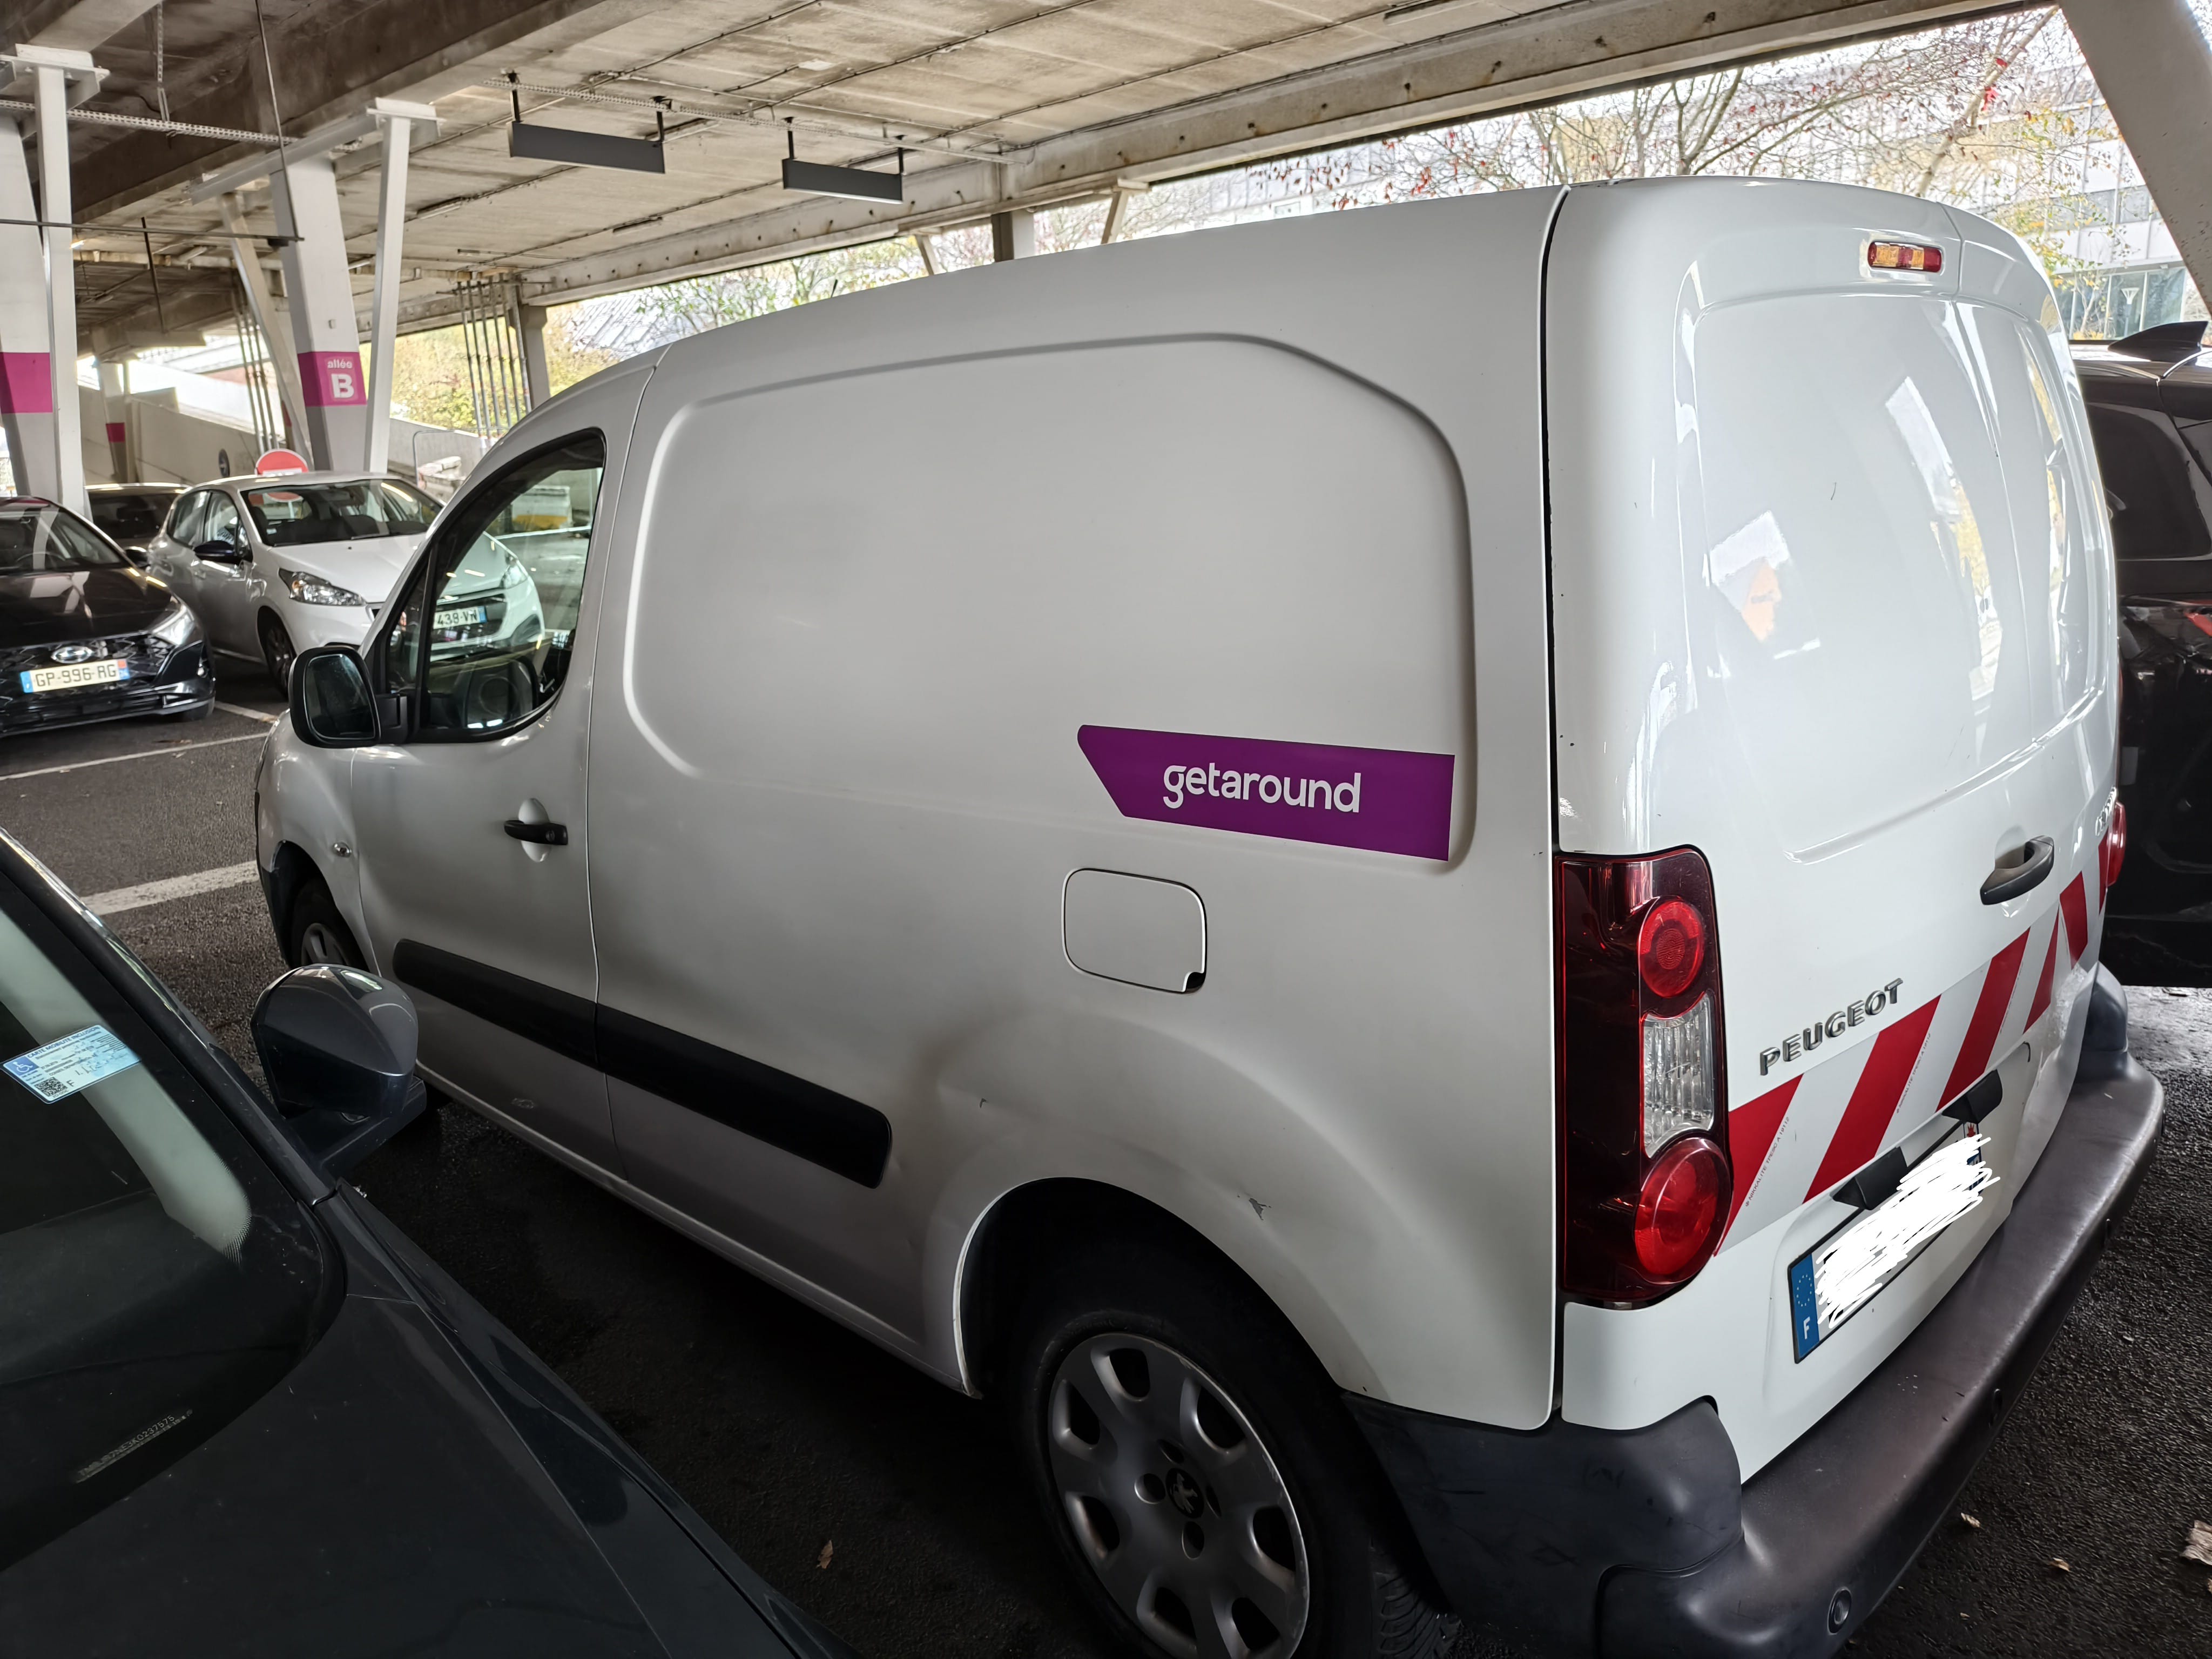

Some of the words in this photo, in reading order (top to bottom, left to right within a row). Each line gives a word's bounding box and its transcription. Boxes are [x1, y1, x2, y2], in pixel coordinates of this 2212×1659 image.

[327, 359, 353, 368] allée
[331, 373, 354, 398] B
[1163, 763, 1361, 813] getaround
[1759, 977, 1904, 1076] PEUGEOT
[27, 1048, 47, 1058] CARTE
[1803, 1316, 1810, 1340] F
